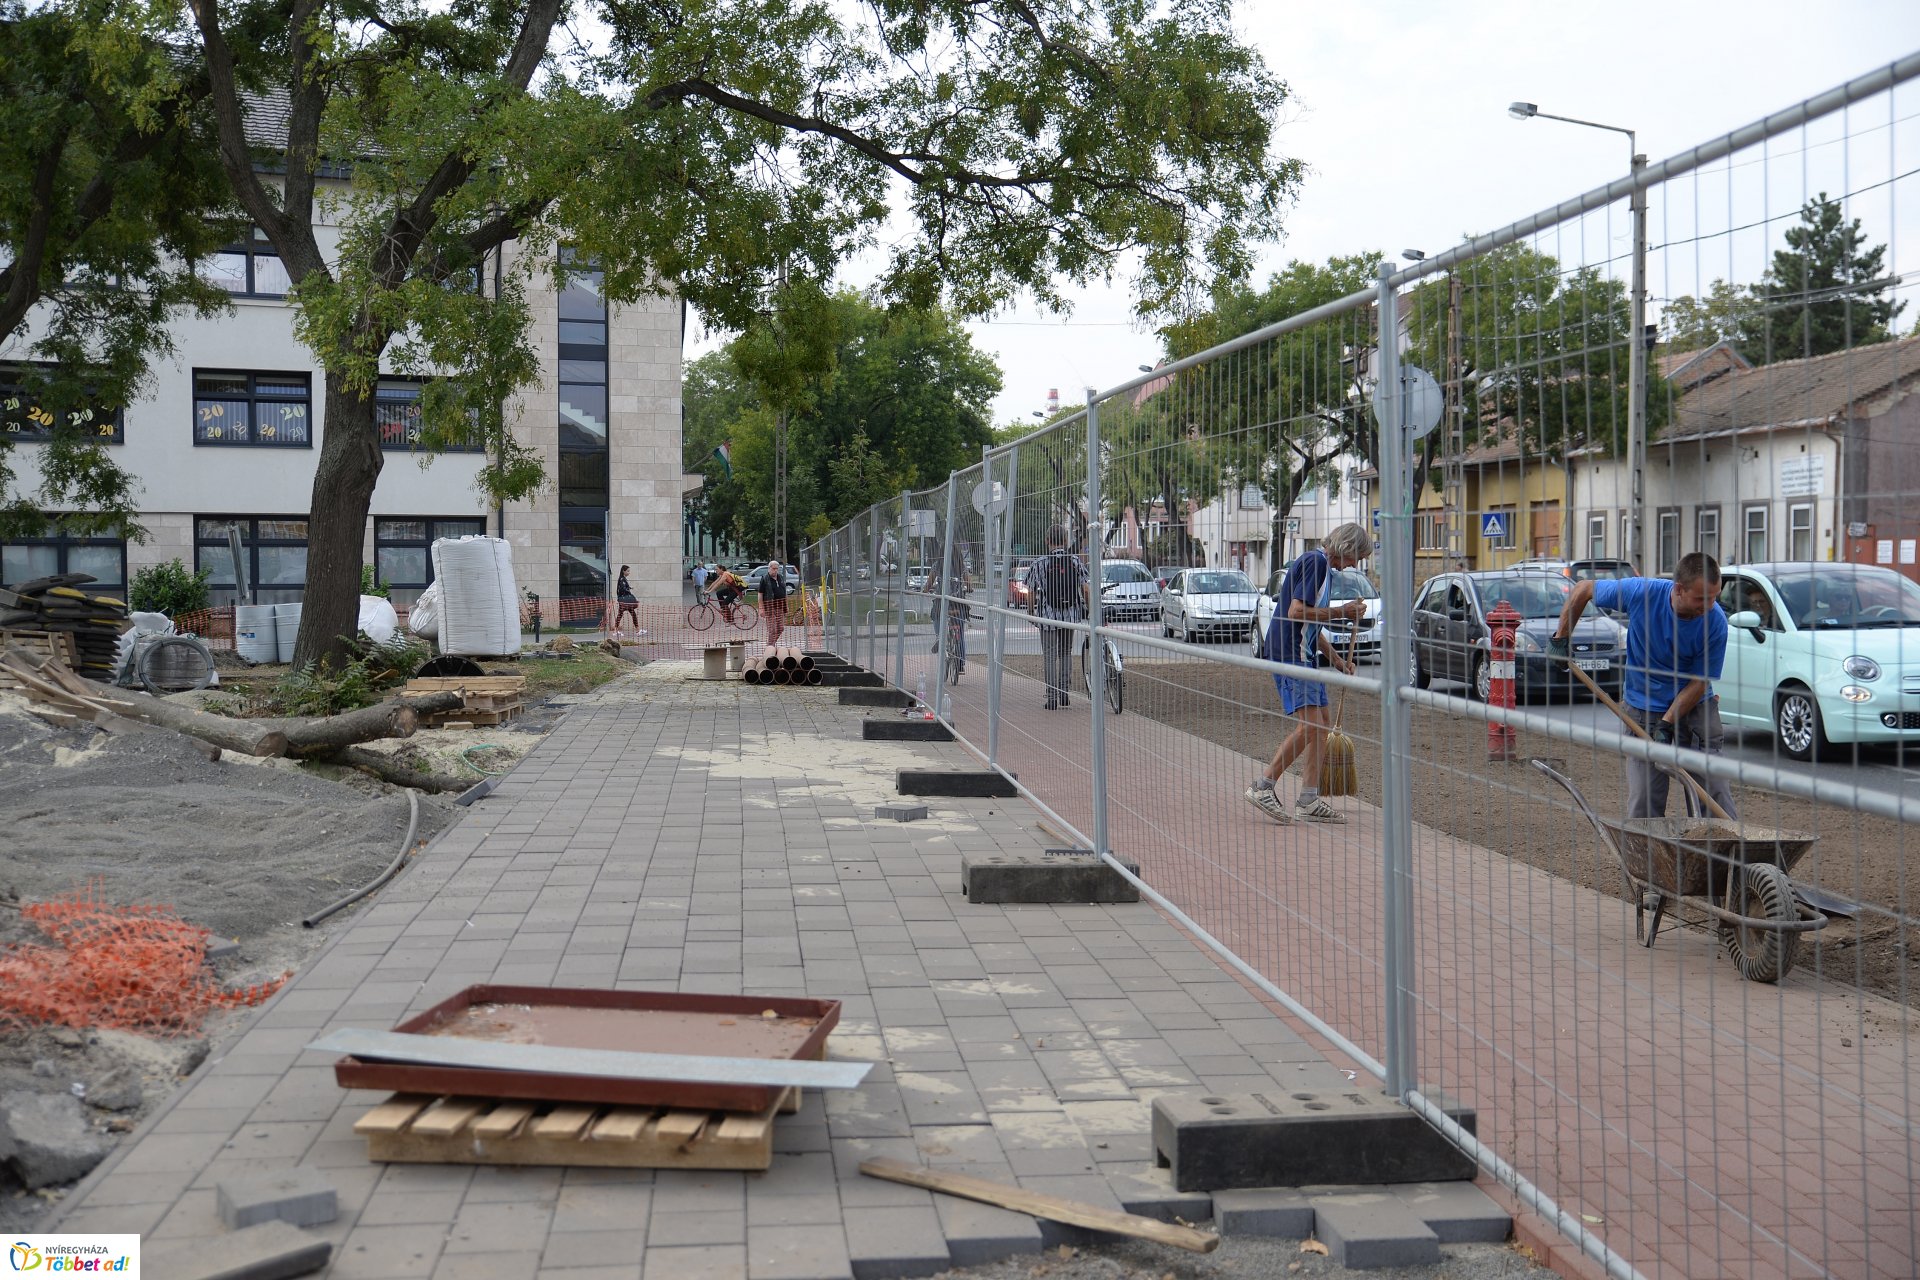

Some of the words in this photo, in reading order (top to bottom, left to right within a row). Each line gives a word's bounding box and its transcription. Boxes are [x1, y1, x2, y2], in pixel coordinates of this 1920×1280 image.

[4, 398, 19, 410] 20
[27, 407, 53, 425] 20
[68, 409, 93, 425] 20
[199, 405, 223, 421] 20
[280, 406, 304, 420] 20
[6, 422, 20, 432] 20
[100, 425, 113, 435] 20
[208, 427, 221, 437] 20
[233, 421, 246, 434] 20
[260, 424, 275, 436] 20
[290, 427, 303, 437] 20
